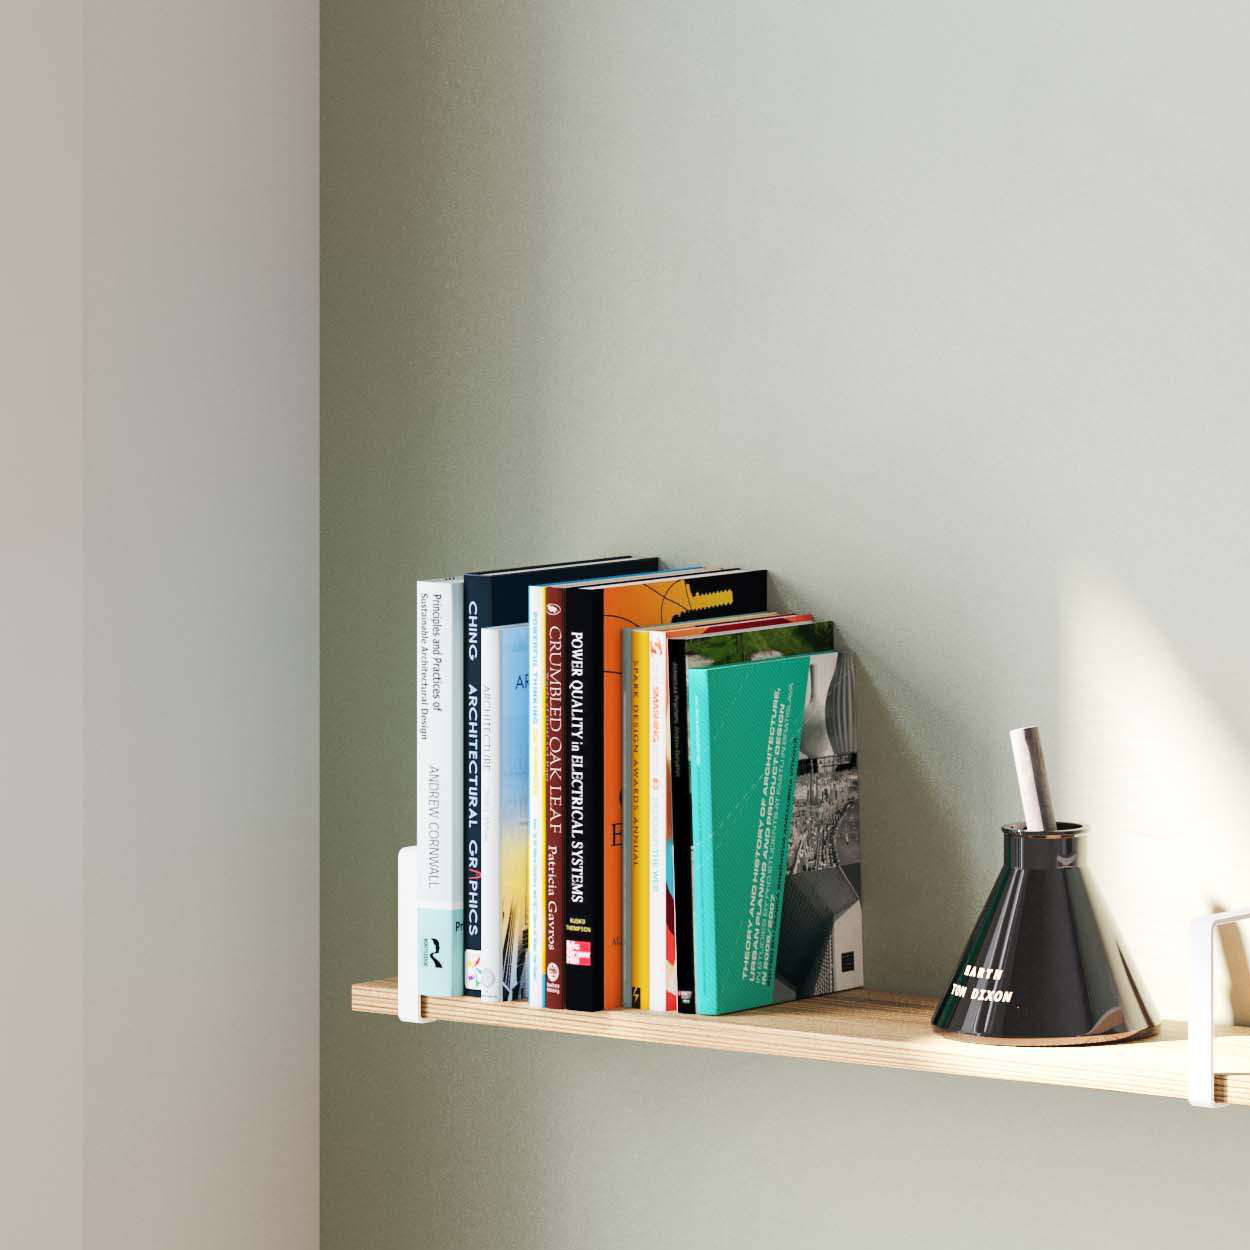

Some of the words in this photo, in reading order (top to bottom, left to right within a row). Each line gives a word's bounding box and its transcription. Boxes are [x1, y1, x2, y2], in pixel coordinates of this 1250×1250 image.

[420, 593, 429, 642] Sustainable
[432, 594, 442, 636] Principles
[467, 600, 479, 660] CHING
[432, 638, 442, 655] and
[571, 631, 584, 676] POWER
[420, 647, 429, 705] Architectural
[432, 658, 442, 699] Practices
[549, 625, 562, 731] CRUMBLED
[632, 660, 640, 699] SPARK
[419, 708, 429, 740] Design
[432, 702, 442, 712] of
[569, 679, 584, 740] QUALITY
[632, 704, 640, 753] DESIGN
[467, 684, 479, 829] ARCHITECTURAL
[549, 735, 562, 781] OAK
[571, 741, 584, 752] in
[428, 766, 440, 817] ANDREW
[571, 754, 584, 838] ELECTRICAL
[632, 759, 640, 811] AWARDS
[759, 798, 767, 817] OF
[549, 786, 562, 835] LEAF
[428, 822, 440, 888] CORNWALL
[632, 817, 640, 866] ANNUAL
[749, 928, 760, 982] URBAN
[761, 827, 771, 860] AND
[766, 759, 779, 826] PRODUCT
[774, 703, 786, 755] DESIGN
[752, 819, 764, 883] HISTORY
[467, 840, 482, 936] GRAPHICS
[547, 845, 558, 896] Patricia
[571, 841, 584, 903] SYSTEMS
[547, 900, 558, 951] Gavros
[748, 885, 758, 918] AND
[742, 920, 753, 979] THEORY
[970, 987, 1013, 1003] DIXON
